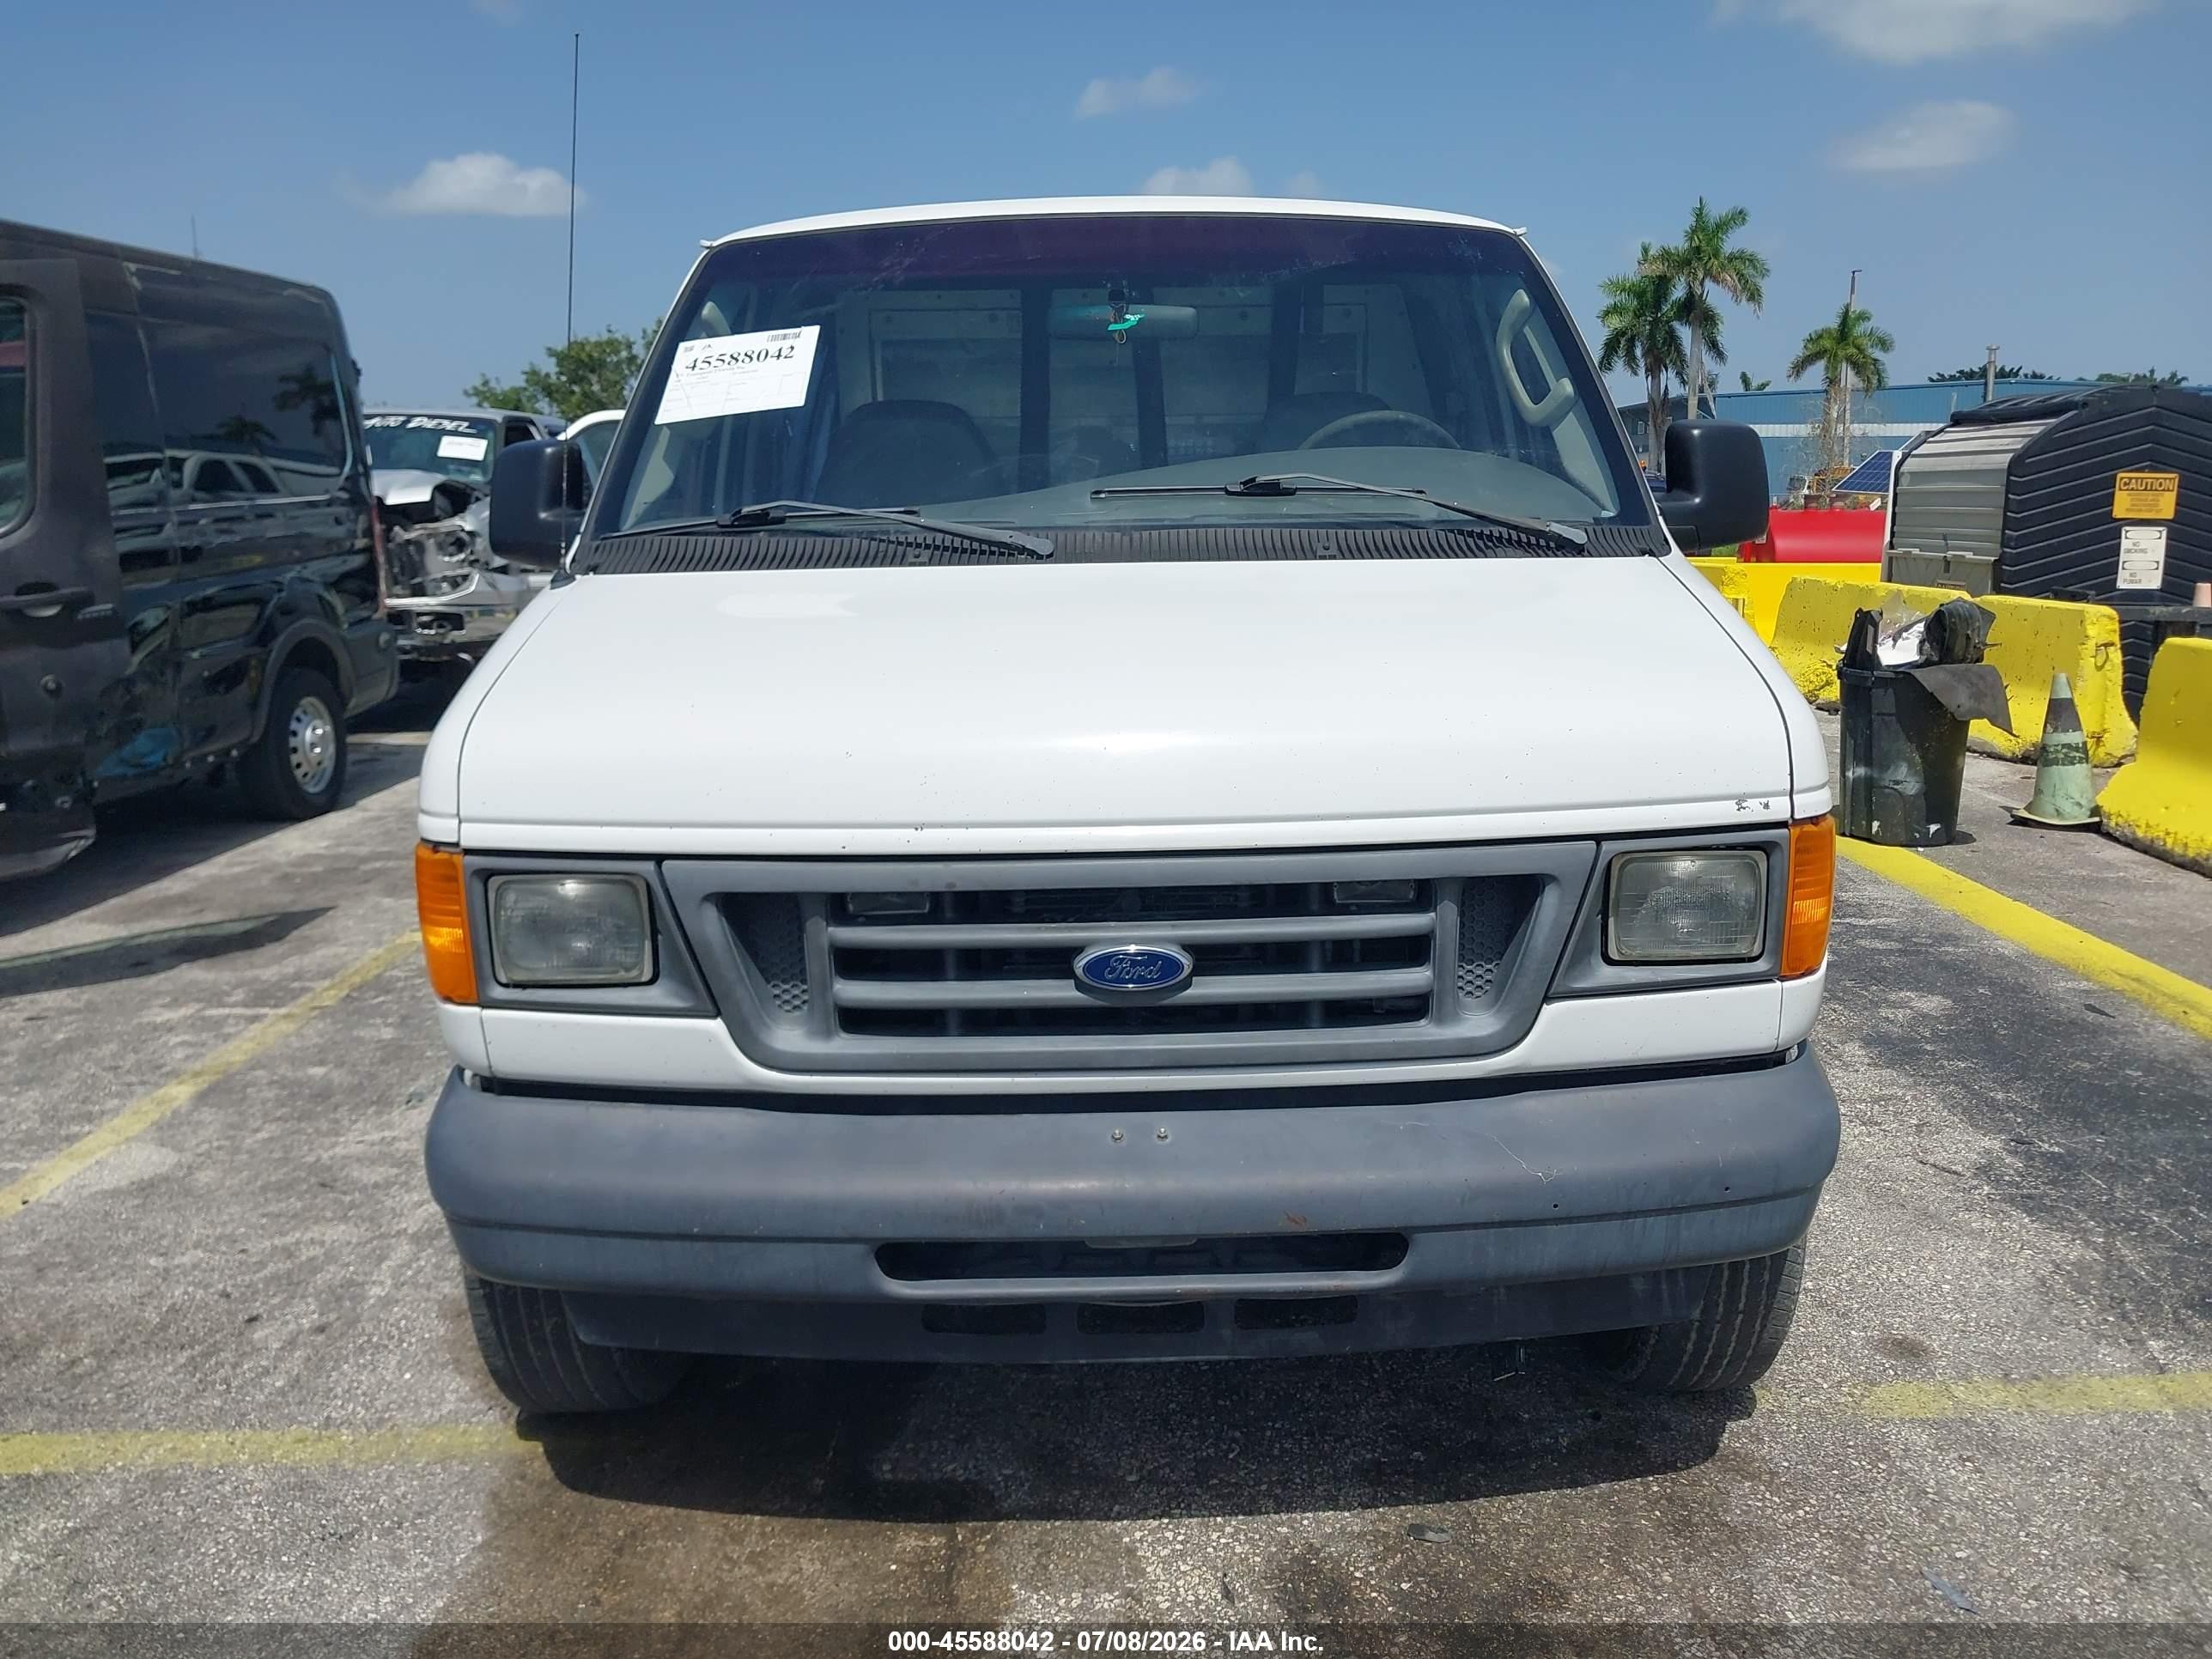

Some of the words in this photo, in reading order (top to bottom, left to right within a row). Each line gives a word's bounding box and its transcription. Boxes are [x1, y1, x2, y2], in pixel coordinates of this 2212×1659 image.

[684, 344, 795, 372] 45588042
[405, 416, 477, 434] DIESEL
[2120, 478, 2174, 490] CAUTION
[1104, 954, 1163, 981] Ford
